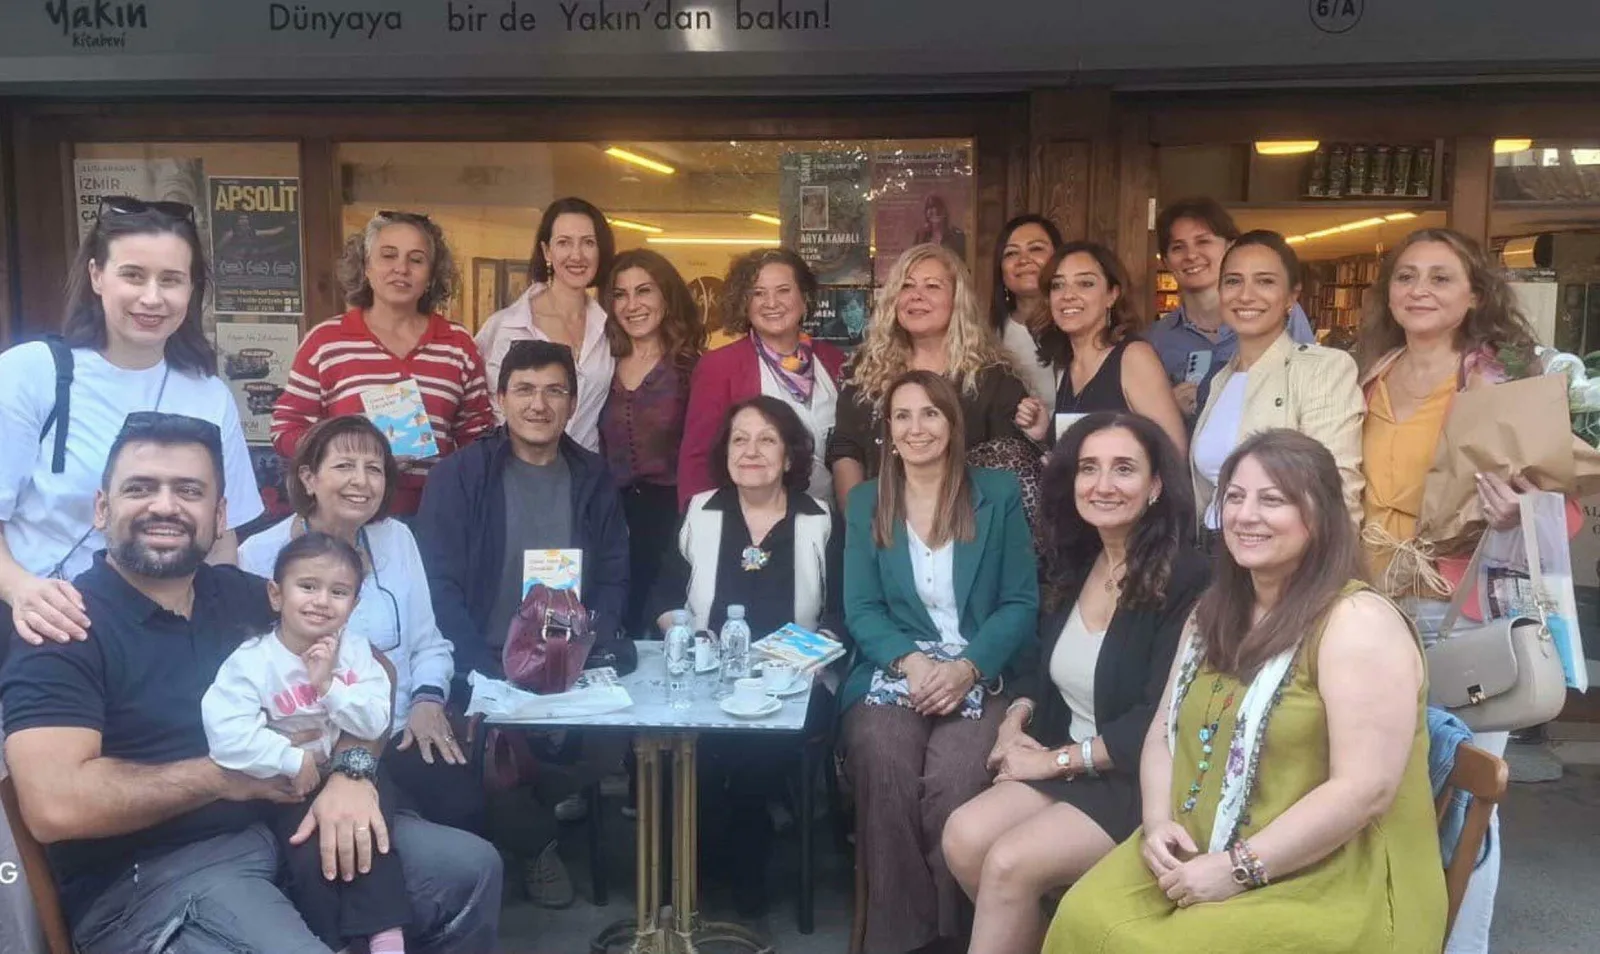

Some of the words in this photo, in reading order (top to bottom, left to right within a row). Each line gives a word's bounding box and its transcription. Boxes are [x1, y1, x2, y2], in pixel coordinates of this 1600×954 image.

[1317, 0, 1355, 17] 6/A
[269, 3, 402, 38] Dünyaya
[447, 1, 487, 32] bir
[500, 3, 536, 31] de
[736, 0, 832, 30] bakın!
[79, 174, 121, 190] İZMİR
[215, 180, 298, 212] APSOLİT
[800, 233, 824, 244] ARYA
